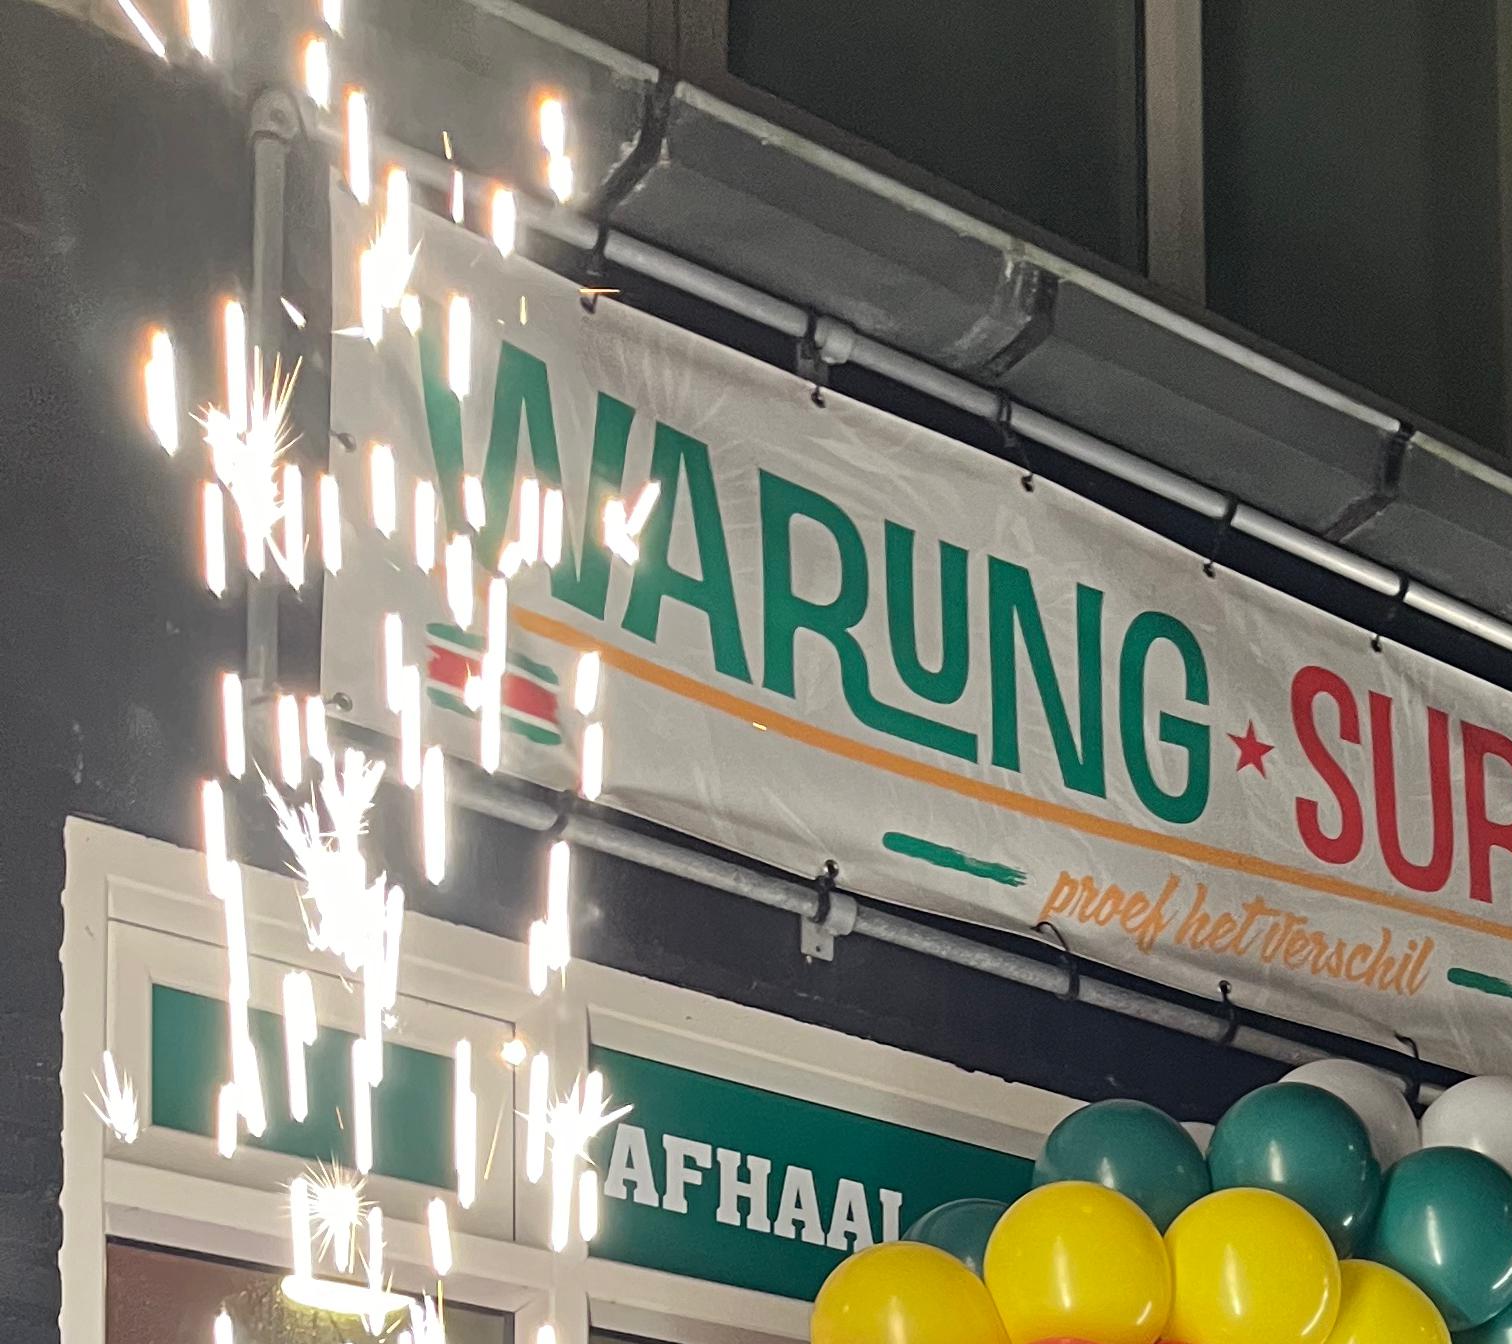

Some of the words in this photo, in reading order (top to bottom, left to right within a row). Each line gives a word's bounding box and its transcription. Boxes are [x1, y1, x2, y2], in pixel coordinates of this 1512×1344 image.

[413, 300, 1212, 826] WARUNG
[1037, 870, 1179, 955] proef
[1173, 883, 1272, 956] het
